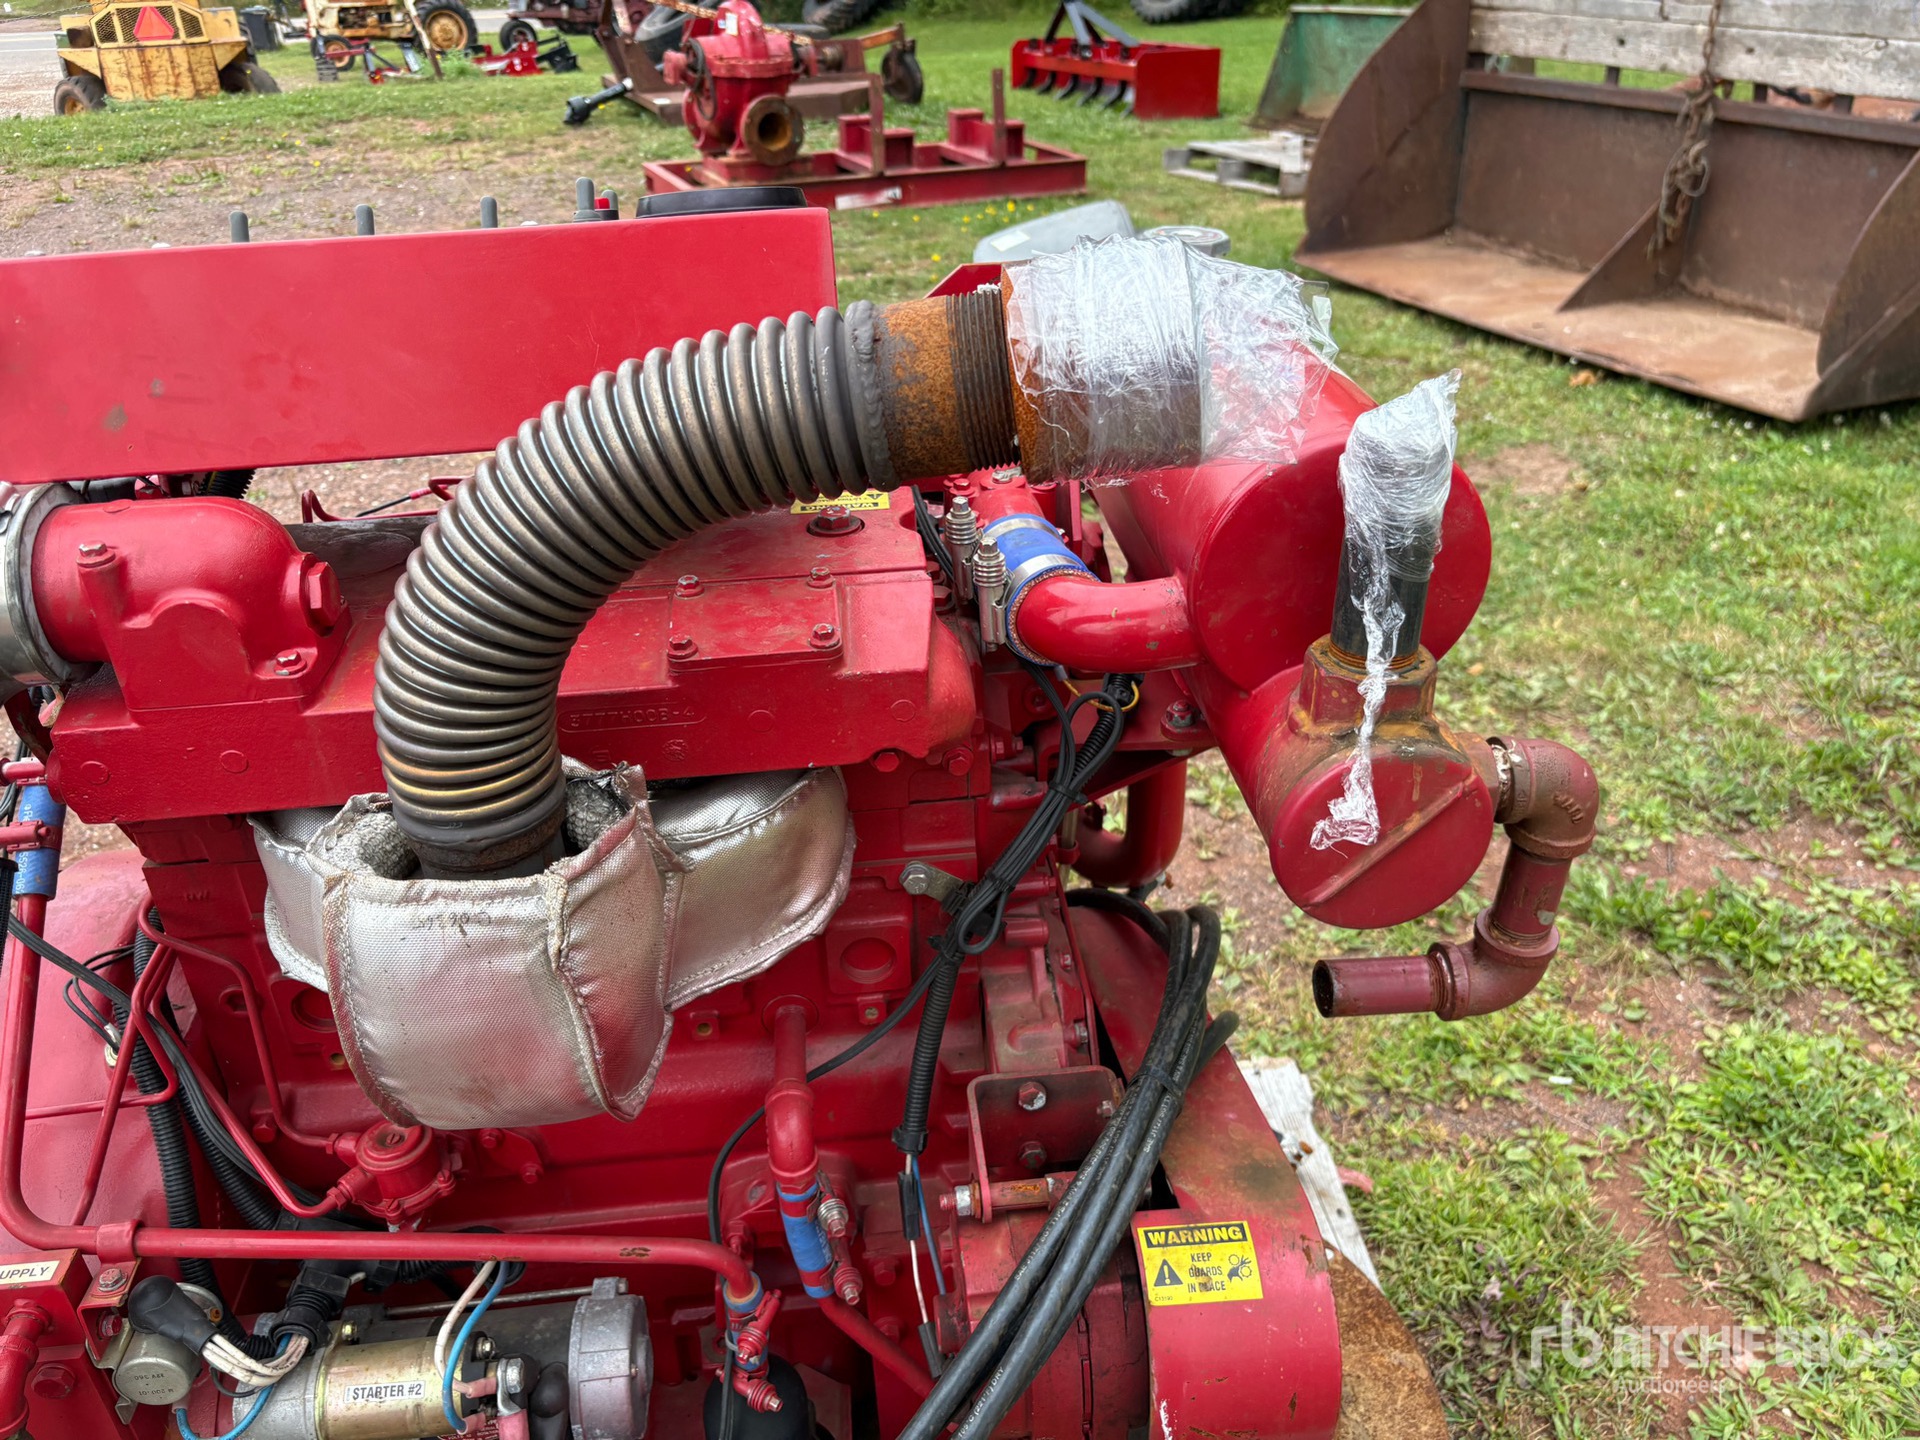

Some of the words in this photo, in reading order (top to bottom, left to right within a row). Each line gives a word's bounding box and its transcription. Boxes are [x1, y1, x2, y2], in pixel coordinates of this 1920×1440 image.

[1147, 1227, 1243, 1246] WARNING
[1190, 1252, 1212, 1262] KEEP
[1188, 1266, 1223, 1278] GUARDS
[1188, 1282, 1196, 1293] IN
[990, 1367, 1004, 1385] DRY
[352, 1385, 406, 1400] STARTER
[408, 1383, 422, 1396] #2
